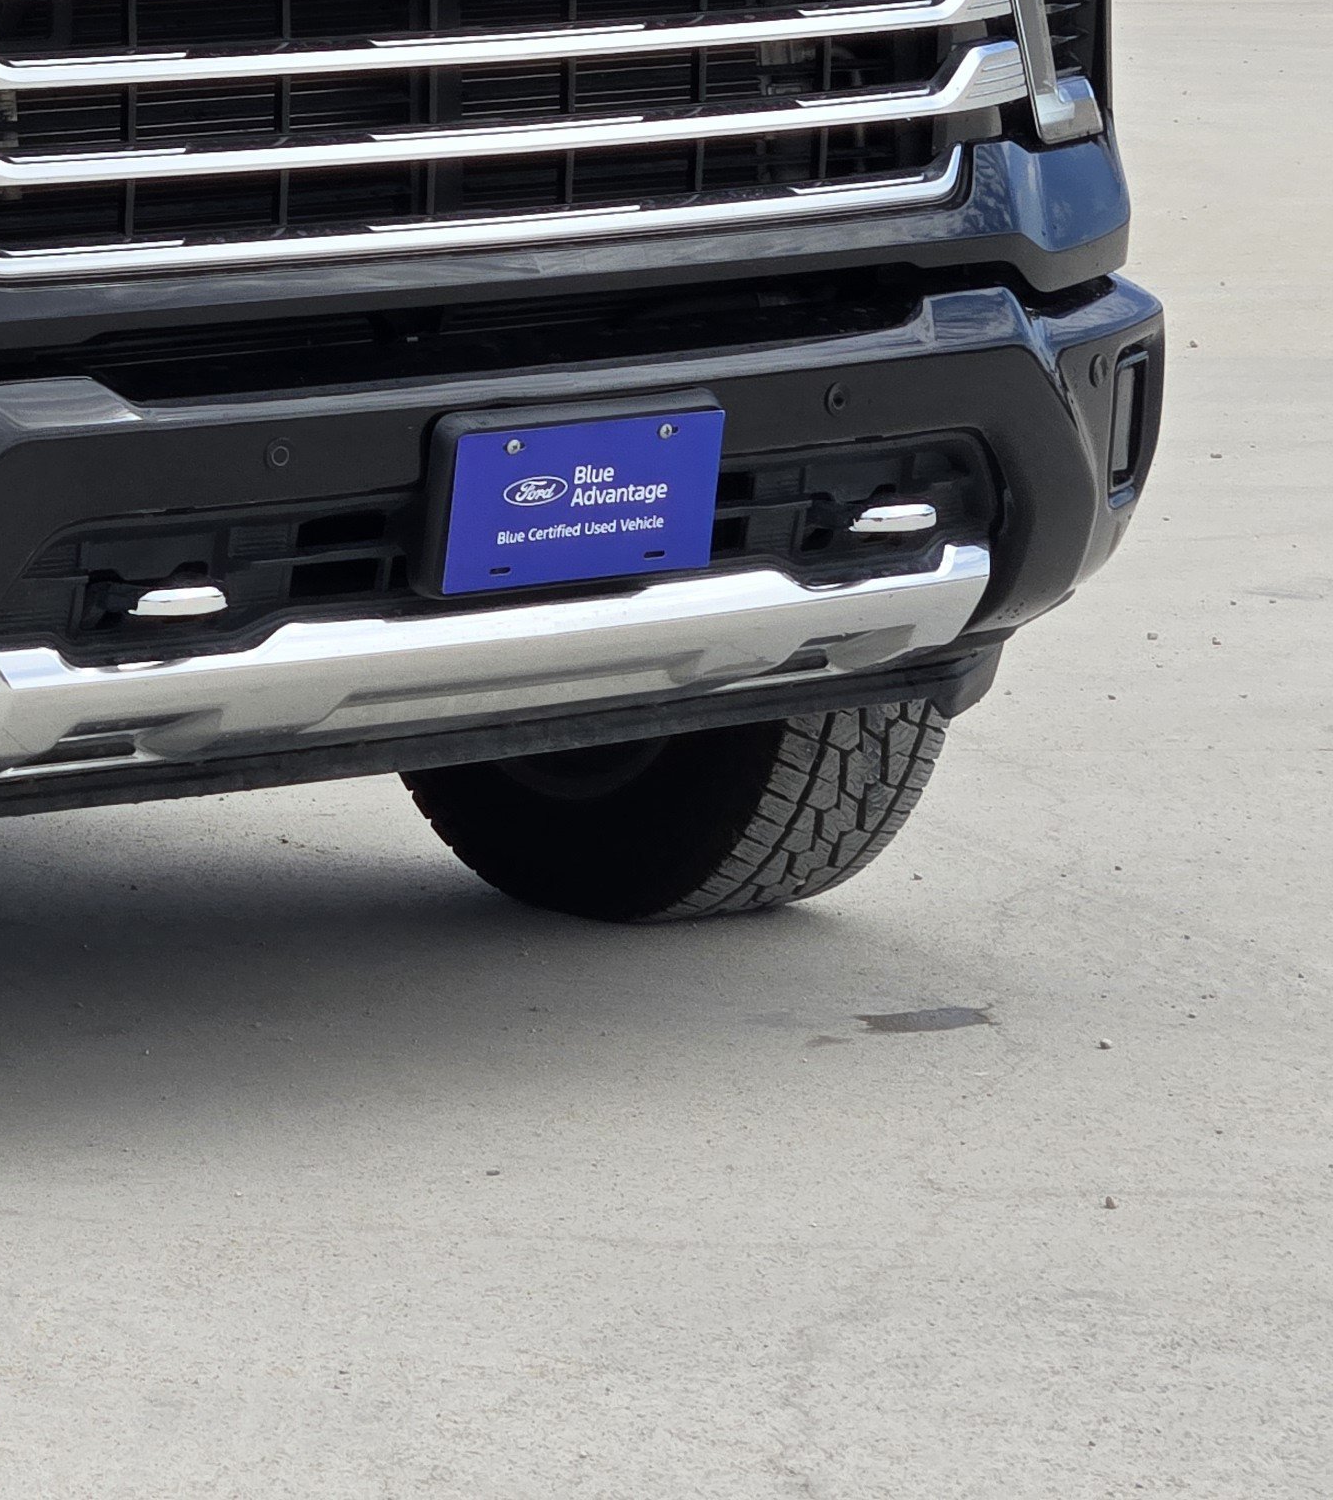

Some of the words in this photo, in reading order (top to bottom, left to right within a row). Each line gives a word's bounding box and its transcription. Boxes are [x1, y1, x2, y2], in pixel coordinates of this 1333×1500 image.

[573, 465, 615, 485] Blue
[514, 480, 556, 502] Ford
[570, 482, 669, 508] Advantage
[496, 529, 525, 546] Blue
[528, 522, 581, 542] Certified
[584, 519, 617, 536] Used
[619, 514, 665, 532] Vehicle
